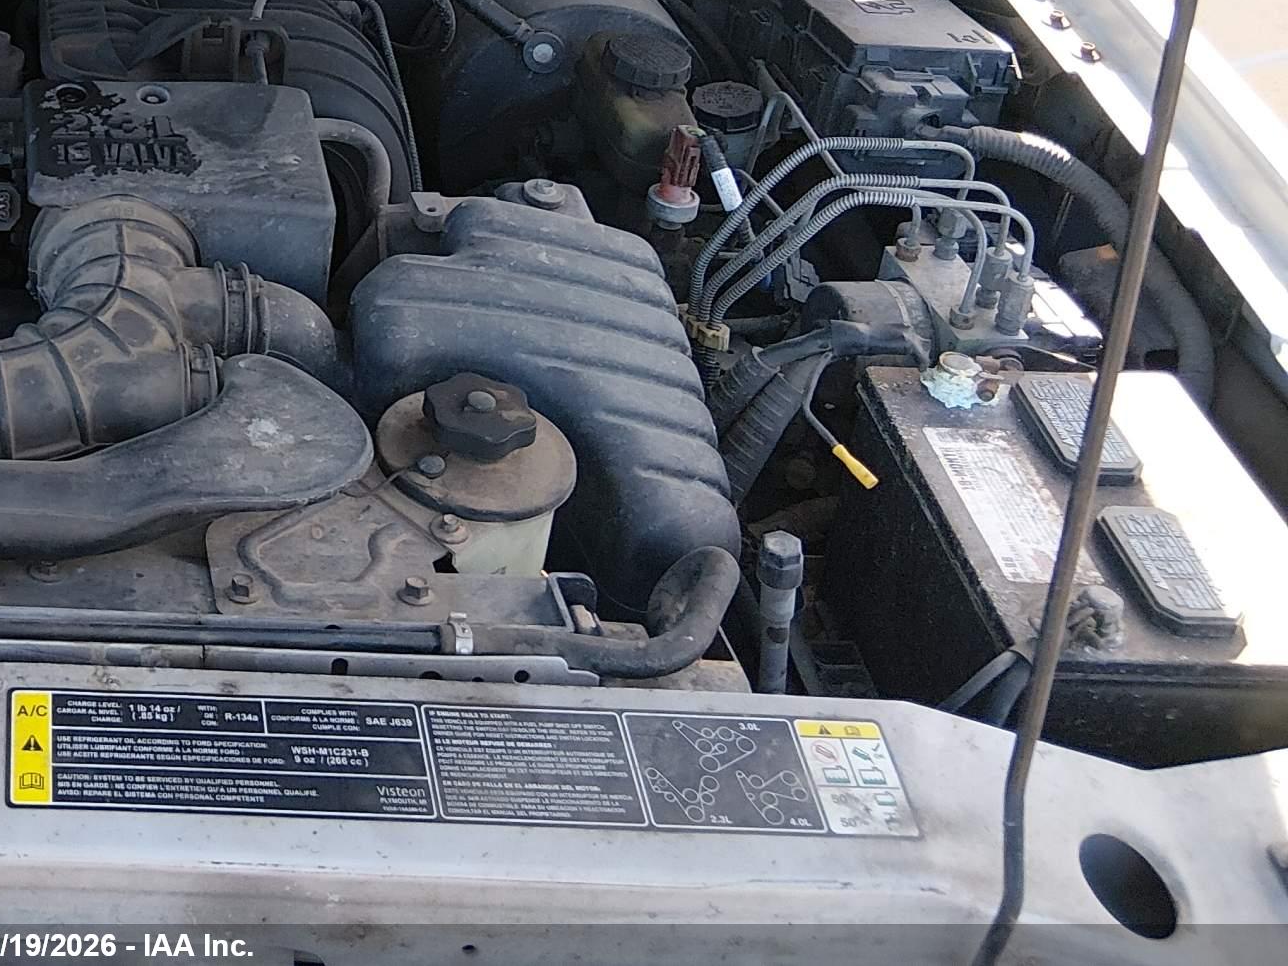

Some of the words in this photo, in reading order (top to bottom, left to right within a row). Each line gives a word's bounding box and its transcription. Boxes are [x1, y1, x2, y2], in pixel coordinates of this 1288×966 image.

[104, 143, 192, 170] VALVE
[67, 700, 97, 708] CHARGE
[17, 705, 48, 717] A/C
[56, 707, 86, 715] CARGAR
[301, 708, 337, 716] COMPLIES
[154, 712, 168, 722] kg
[224, 712, 259, 722] R-134a
[365, 717, 387, 726] SAE
[389, 719, 413, 727] J639
[738, 722, 760, 731] 3.0L
[72, 736, 123, 744] REFRIGERANT
[137, 738, 180, 746] ACCORDING
[213, 740, 268, 748] SPECIFICATION:
[56, 743, 89, 751] UTILISER
[90, 744, 132, 752] LUBRIFIANT
[133, 746, 174, 754] CONFORME
[192, 747, 219, 755] NORME
[290, 745, 369, 757] WSH-M1C231-B
[72, 751, 99, 759] ACEITE
[99, 752, 155, 761] REFRIGERANTE
[182, 755, 251, 764] ESPECIFICACIONES
[263, 757, 285, 765] FORD:
[294, 755, 301, 763] 9
[57, 773, 92, 781] CAUTION:
[93, 774, 123, 782] SYSTEM
[146, 776, 183, 784] SERVICED
[195, 778, 234, 786] QUALIFIED
[126, 783, 158, 791] CONFIER
[226, 786, 237, 794] UN
[238, 787, 282, 795] PERSONNEL
[376, 785, 426, 797] Visteon
[124, 791, 156, 799] SISTEMA
[175, 793, 214, 801] PERSONAL
[215, 794, 265, 803] COMPETENTE
[709, 815, 733, 824] 2.3L
[789, 817, 812, 827] 4.0L
